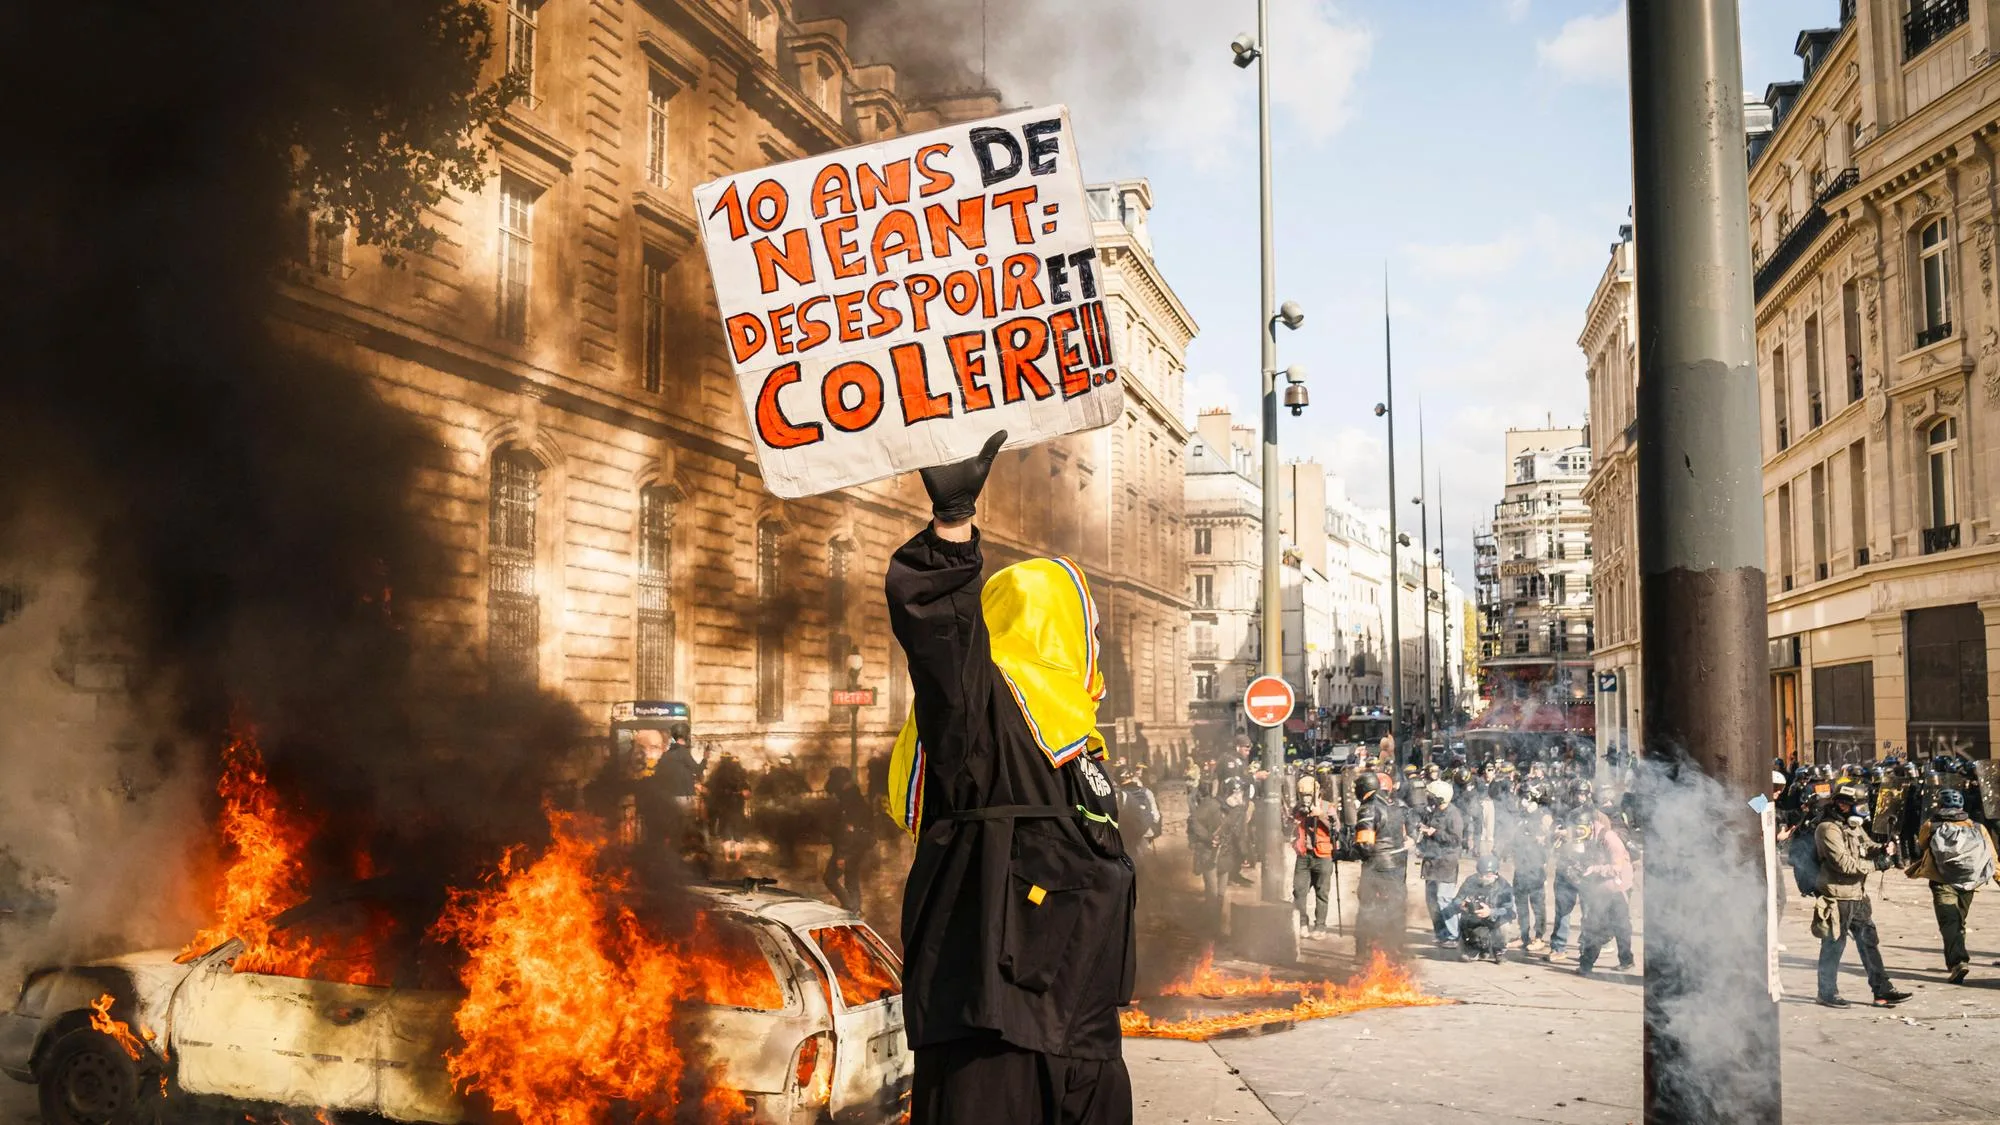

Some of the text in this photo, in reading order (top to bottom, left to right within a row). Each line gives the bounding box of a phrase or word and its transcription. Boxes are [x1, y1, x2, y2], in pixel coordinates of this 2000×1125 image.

[708, 118, 1062, 241] 10 ANS DE
[750, 185, 1060, 294] NEANT:
[1045, 247, 1097, 306] ET
[754, 300, 1118, 450] COLERE!!
